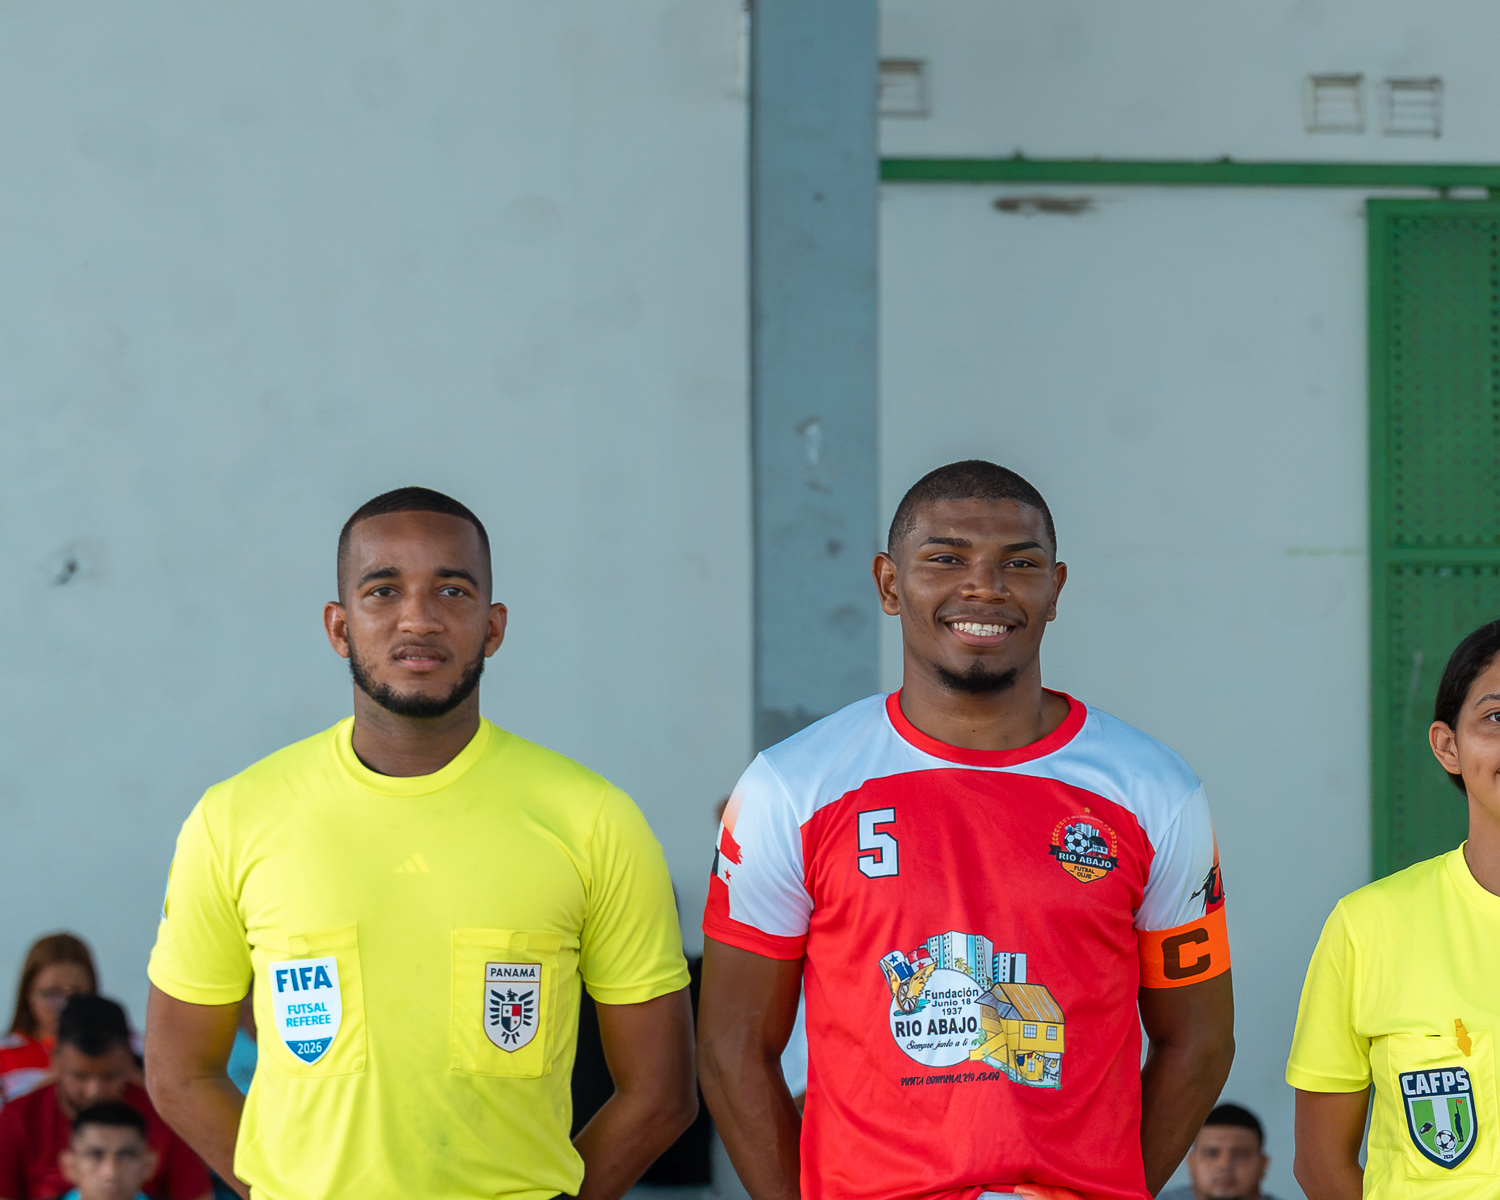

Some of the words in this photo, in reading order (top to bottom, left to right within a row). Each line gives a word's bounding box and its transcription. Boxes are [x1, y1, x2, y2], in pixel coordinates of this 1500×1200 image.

[857, 806, 899, 879] 5
[1058, 852, 1077, 862] RIO
[1078, 856, 1112, 869] ABAJO
[1161, 927, 1212, 980] C
[276, 965, 333, 993] FIFA
[490, 967, 536, 977] PANAMÁ
[924, 987, 979, 1000] Fundación
[287, 1002, 328, 1015] FUTSAL
[932, 999, 958, 1007] Junio
[941, 1007, 963, 1016] 1937
[286, 1014, 331, 1028] REFEREE
[895, 1019, 922, 1038] RIO
[927, 1016, 977, 1036] ABAJO
[297, 1041, 323, 1054] 2026
[1401, 1069, 1470, 1096] CAFPS
